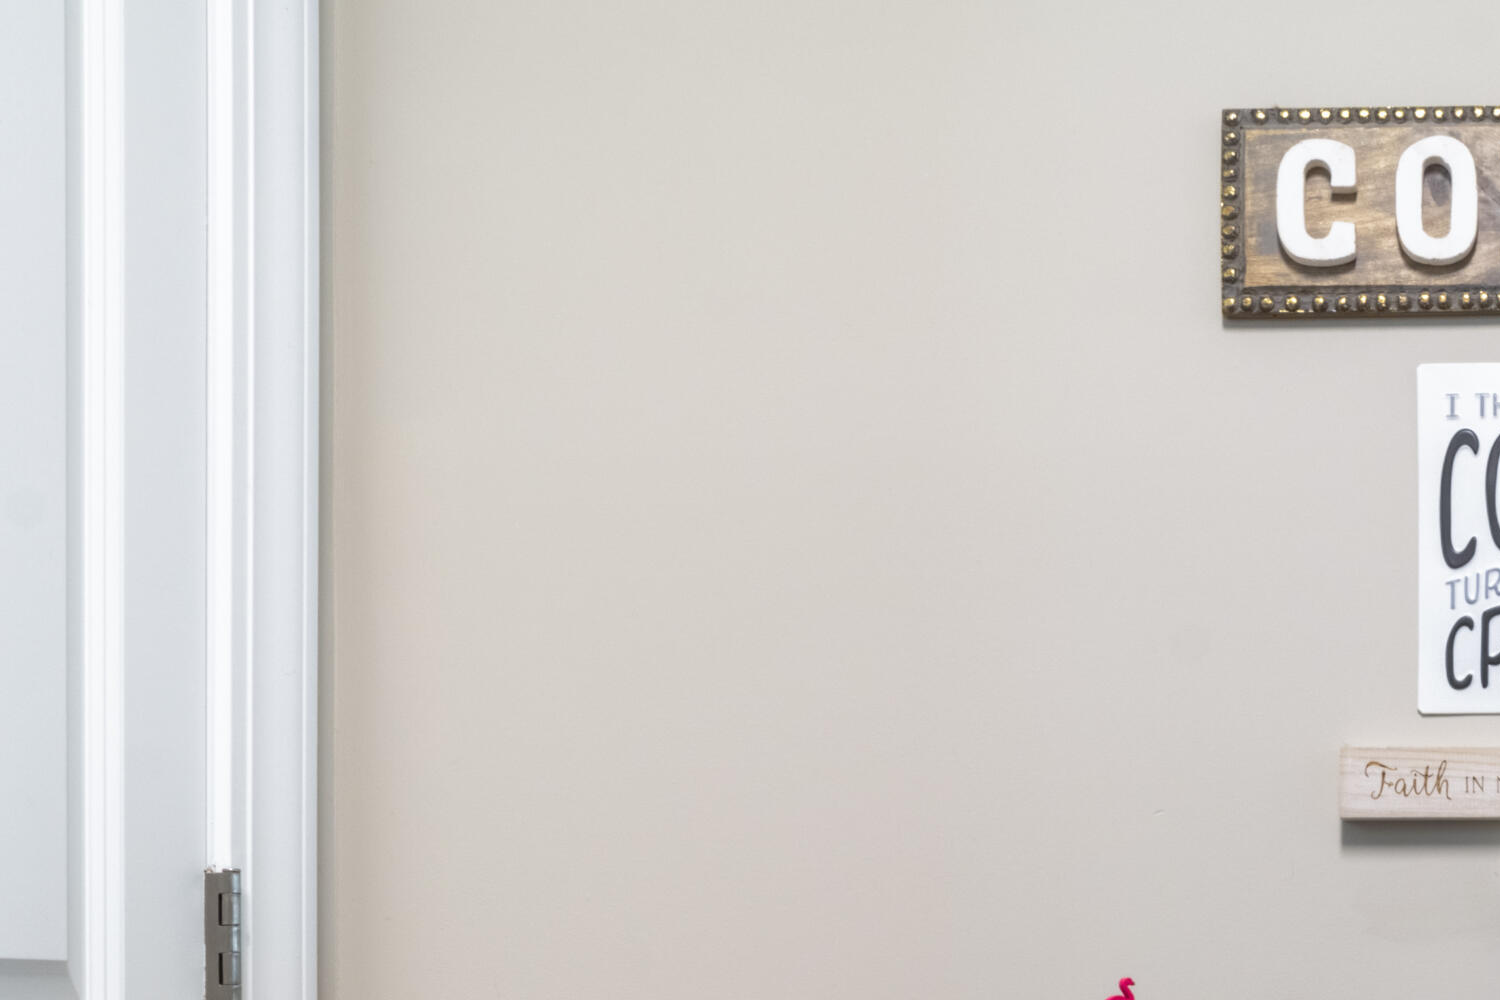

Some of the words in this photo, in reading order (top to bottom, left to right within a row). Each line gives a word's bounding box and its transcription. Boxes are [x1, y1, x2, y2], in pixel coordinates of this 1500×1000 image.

[1445, 393, 1459, 419] I
[1363, 760, 1453, 801] Faith
[1465, 776, 1484, 793] IN
